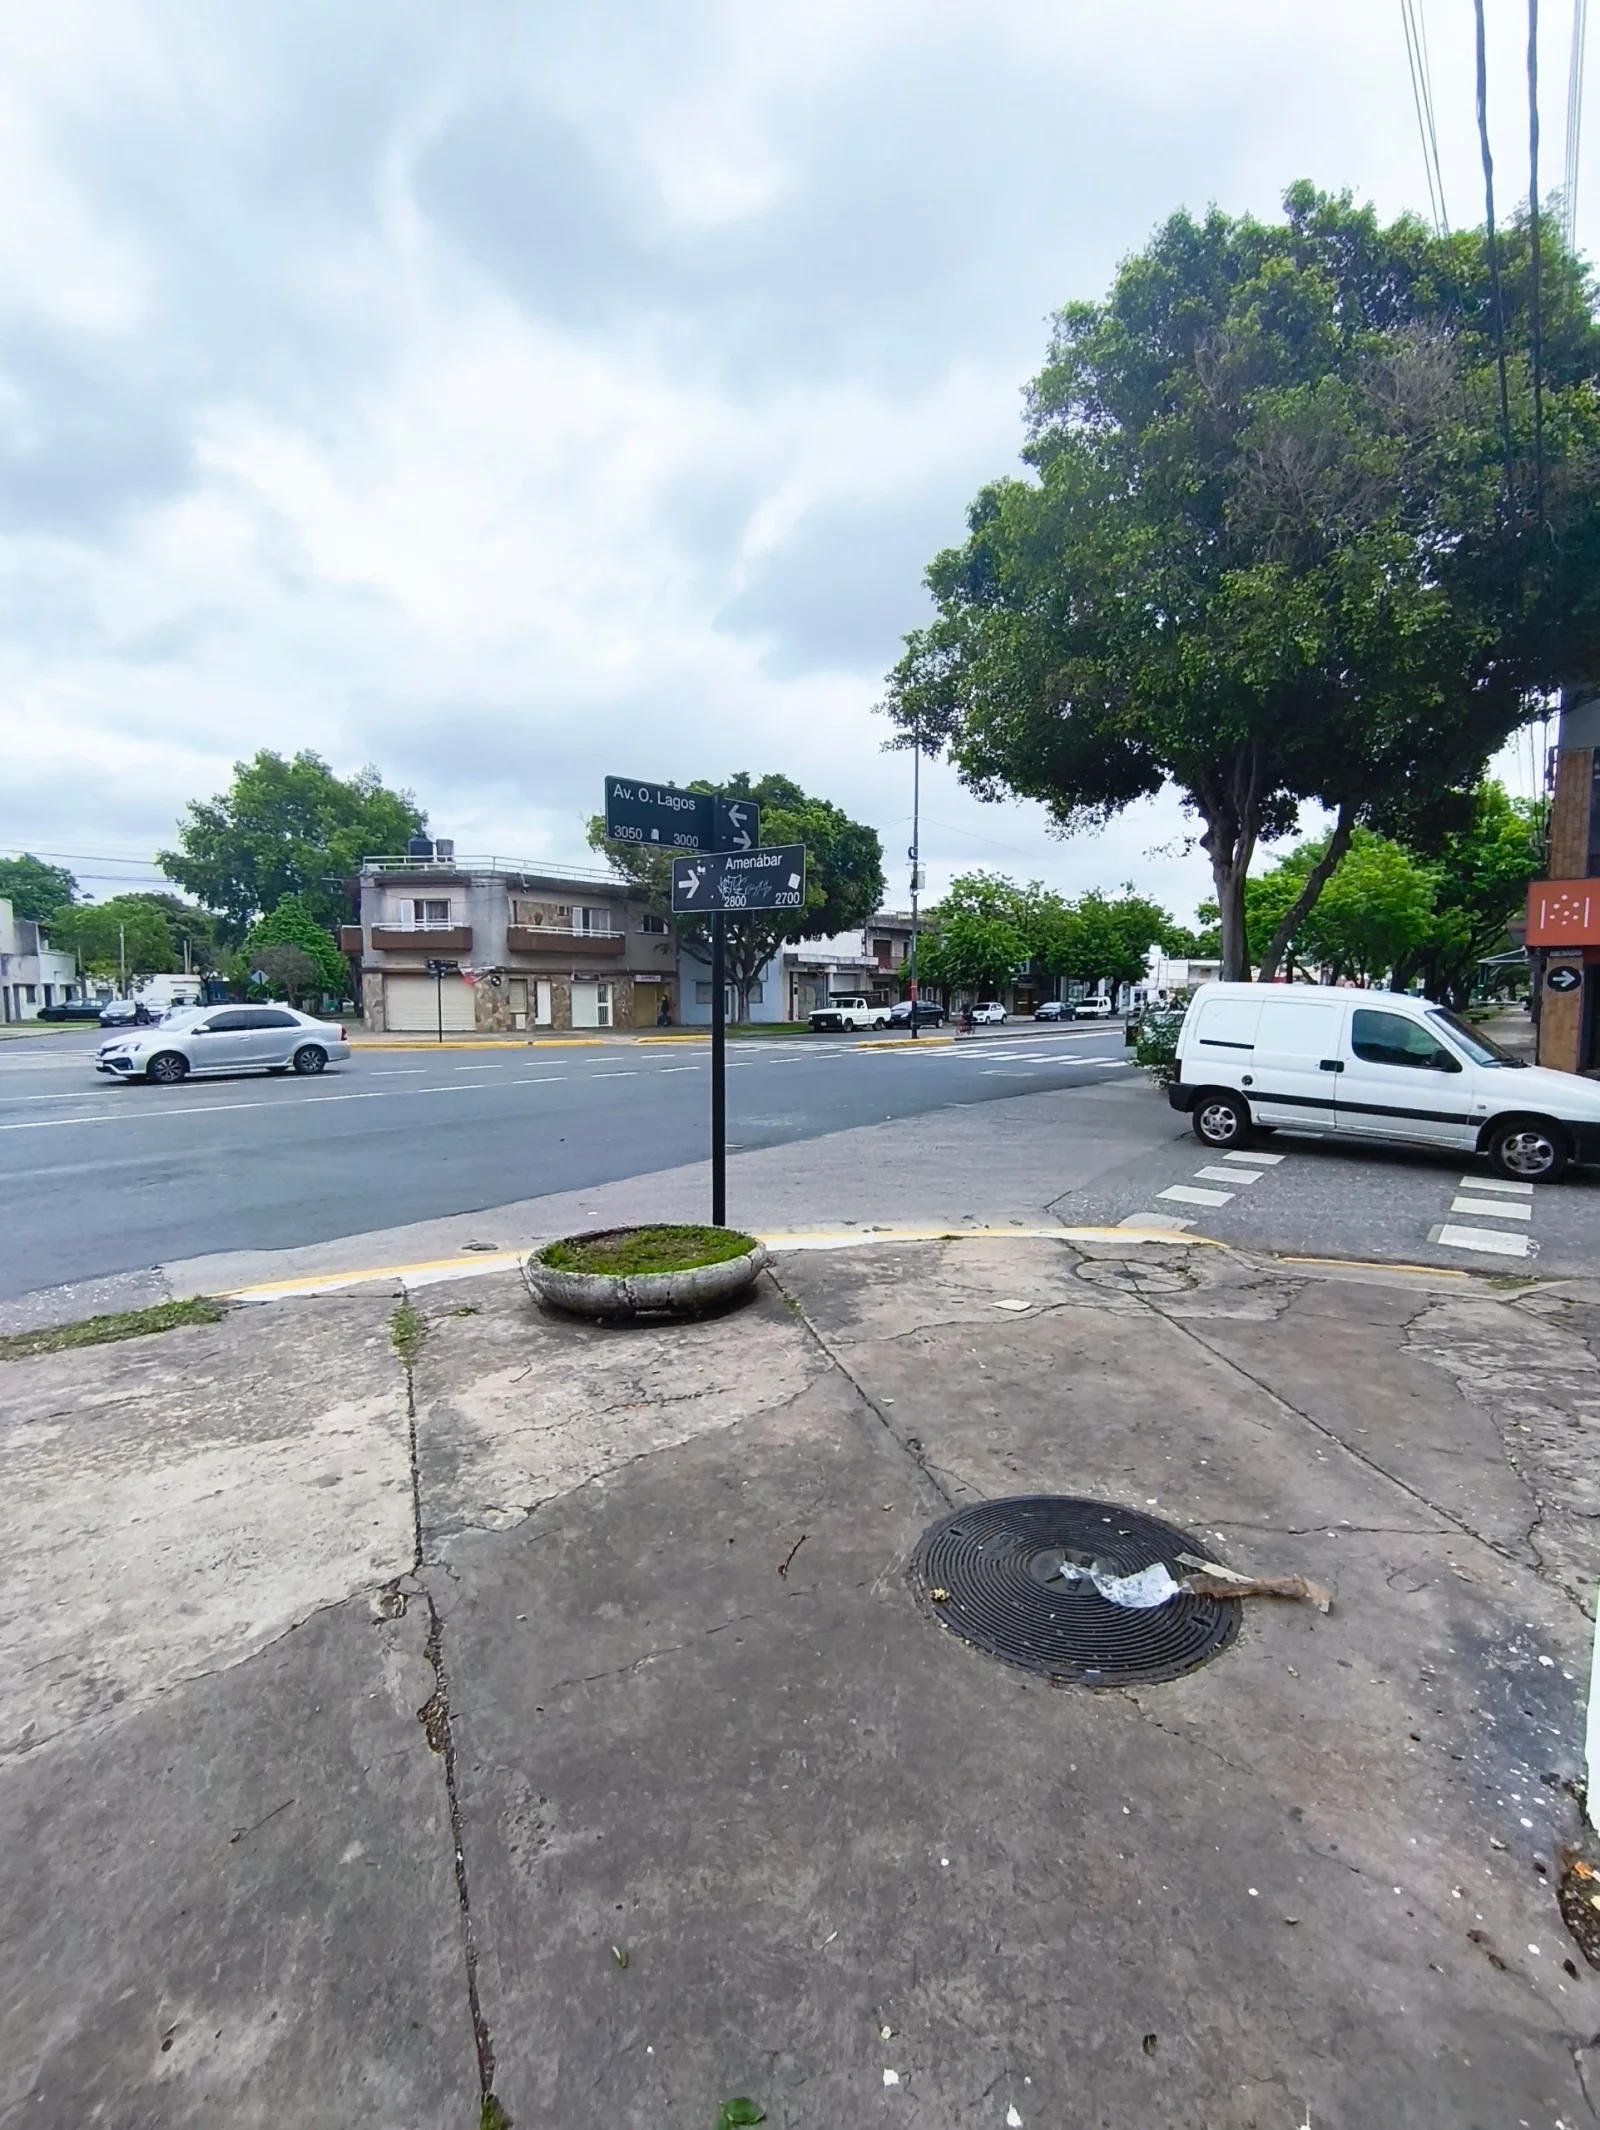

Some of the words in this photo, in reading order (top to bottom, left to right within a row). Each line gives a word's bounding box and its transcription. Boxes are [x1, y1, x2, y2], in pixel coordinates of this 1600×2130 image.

[613, 783, 634, 800] Av.
[638, 788, 653, 804] O.
[657, 791, 696, 811] Lagos
[614, 825, 643, 840] 3050
[673, 833, 699, 848] 3000
[725, 853, 783, 870] Amenábar
[723, 895, 747, 908] 2800
[774, 892, 800, 905] 2700
